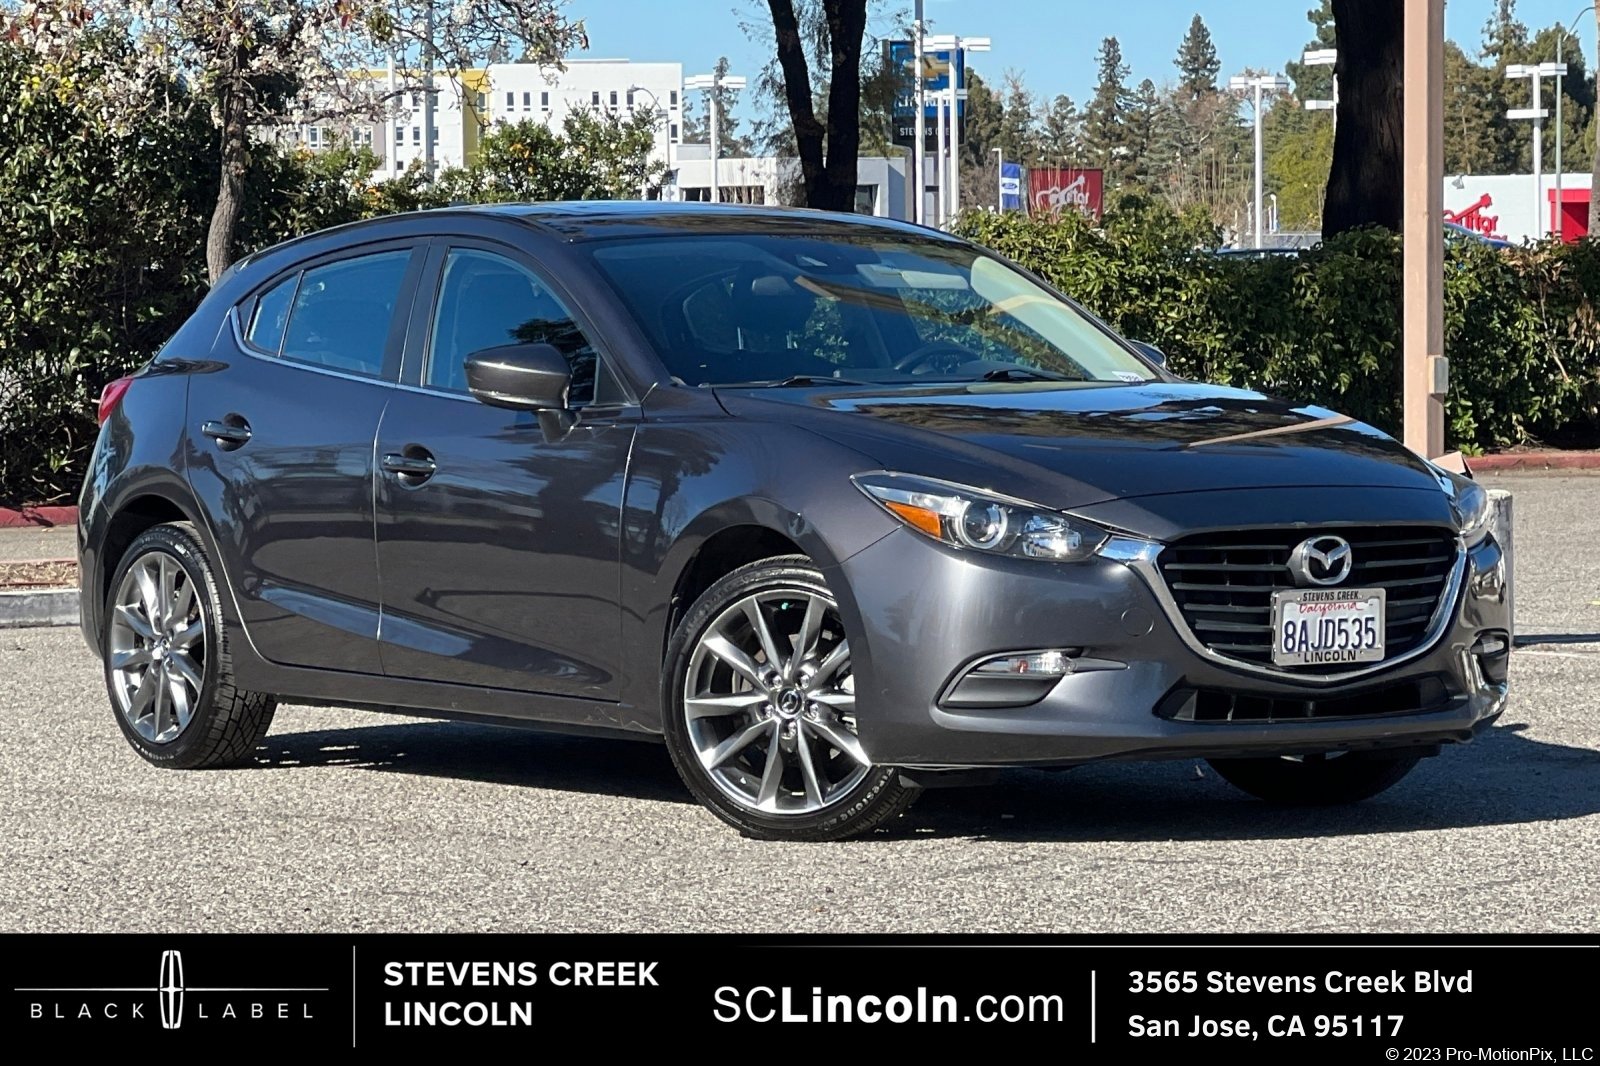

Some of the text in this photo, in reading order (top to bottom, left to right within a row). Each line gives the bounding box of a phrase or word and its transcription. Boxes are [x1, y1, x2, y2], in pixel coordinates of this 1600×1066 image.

[900, 127, 932, 137] STENS
[1303, 590, 1359, 602] STEVENS CREEK
[1299, 601, 1364, 617] California
[1283, 616, 1376, 652] 8AJD535
[1303, 651, 1357, 663] LINCOLN
